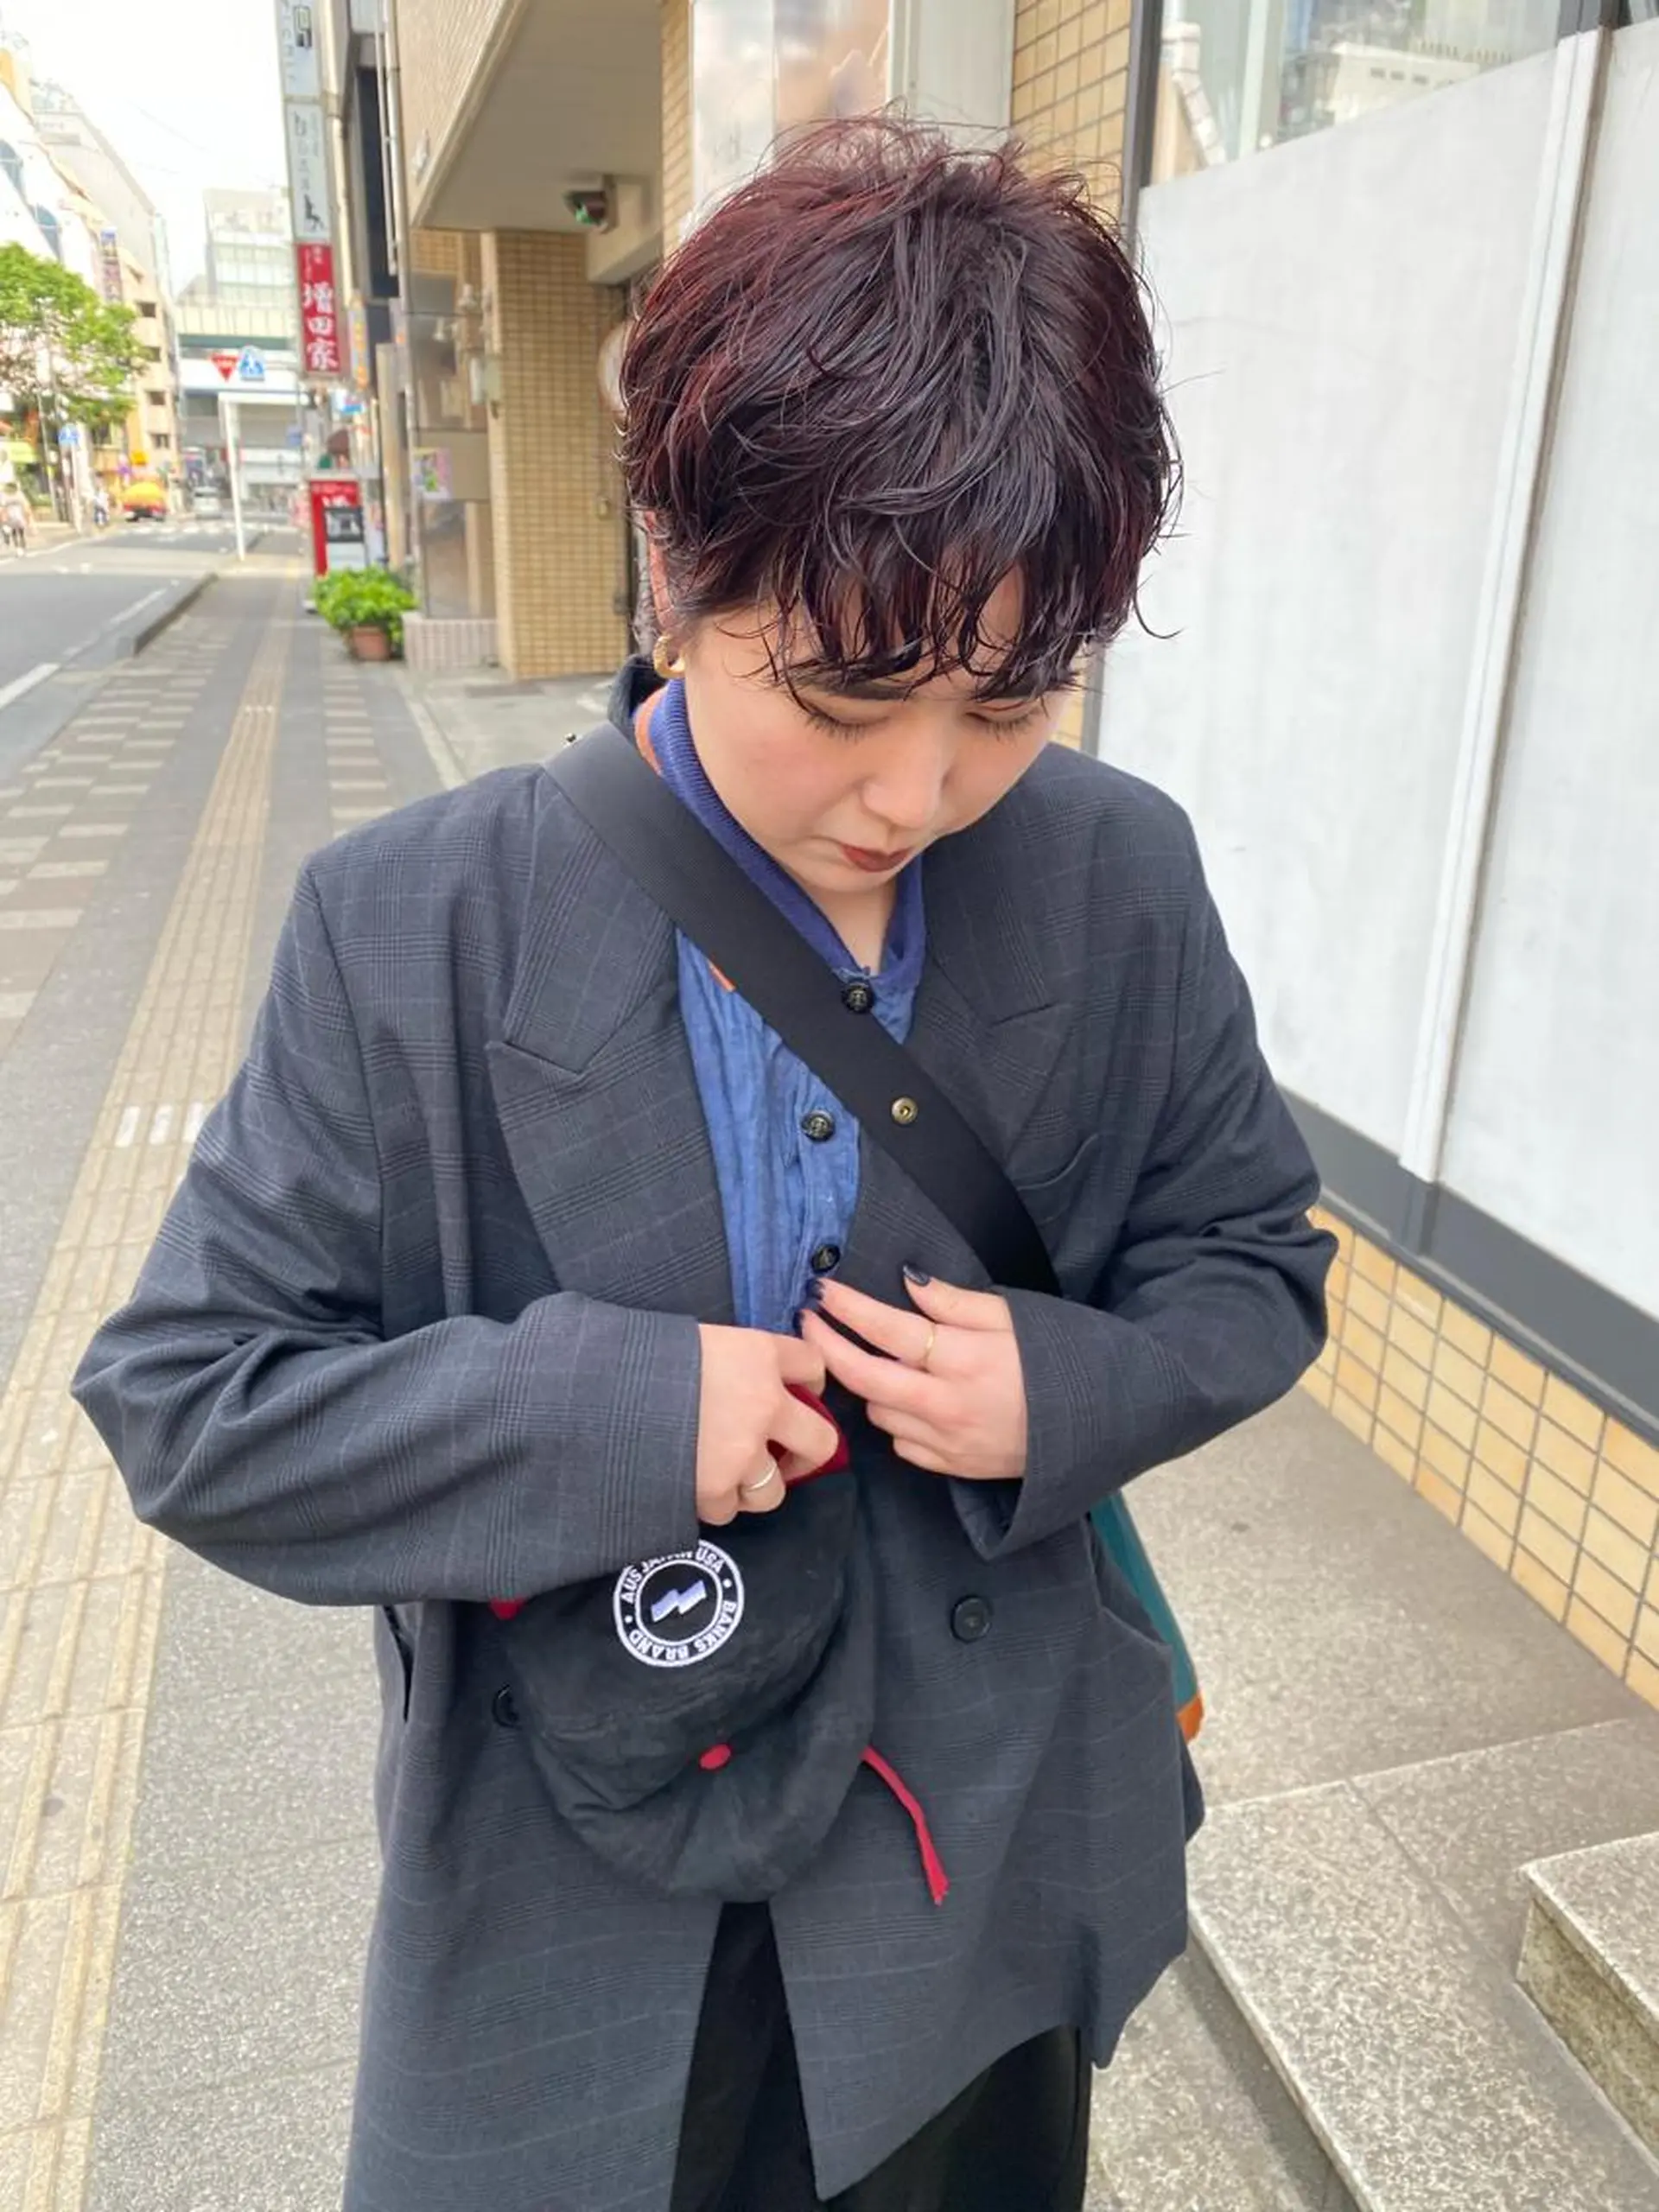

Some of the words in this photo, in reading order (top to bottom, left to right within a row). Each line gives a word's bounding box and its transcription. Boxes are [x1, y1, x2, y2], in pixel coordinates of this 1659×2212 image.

[620, 1568, 643, 1604] AUS
[695, 1547, 725, 1573] USA
[629, 1629, 690, 1661] BRAND
[694, 1600, 737, 1653] BANKS
